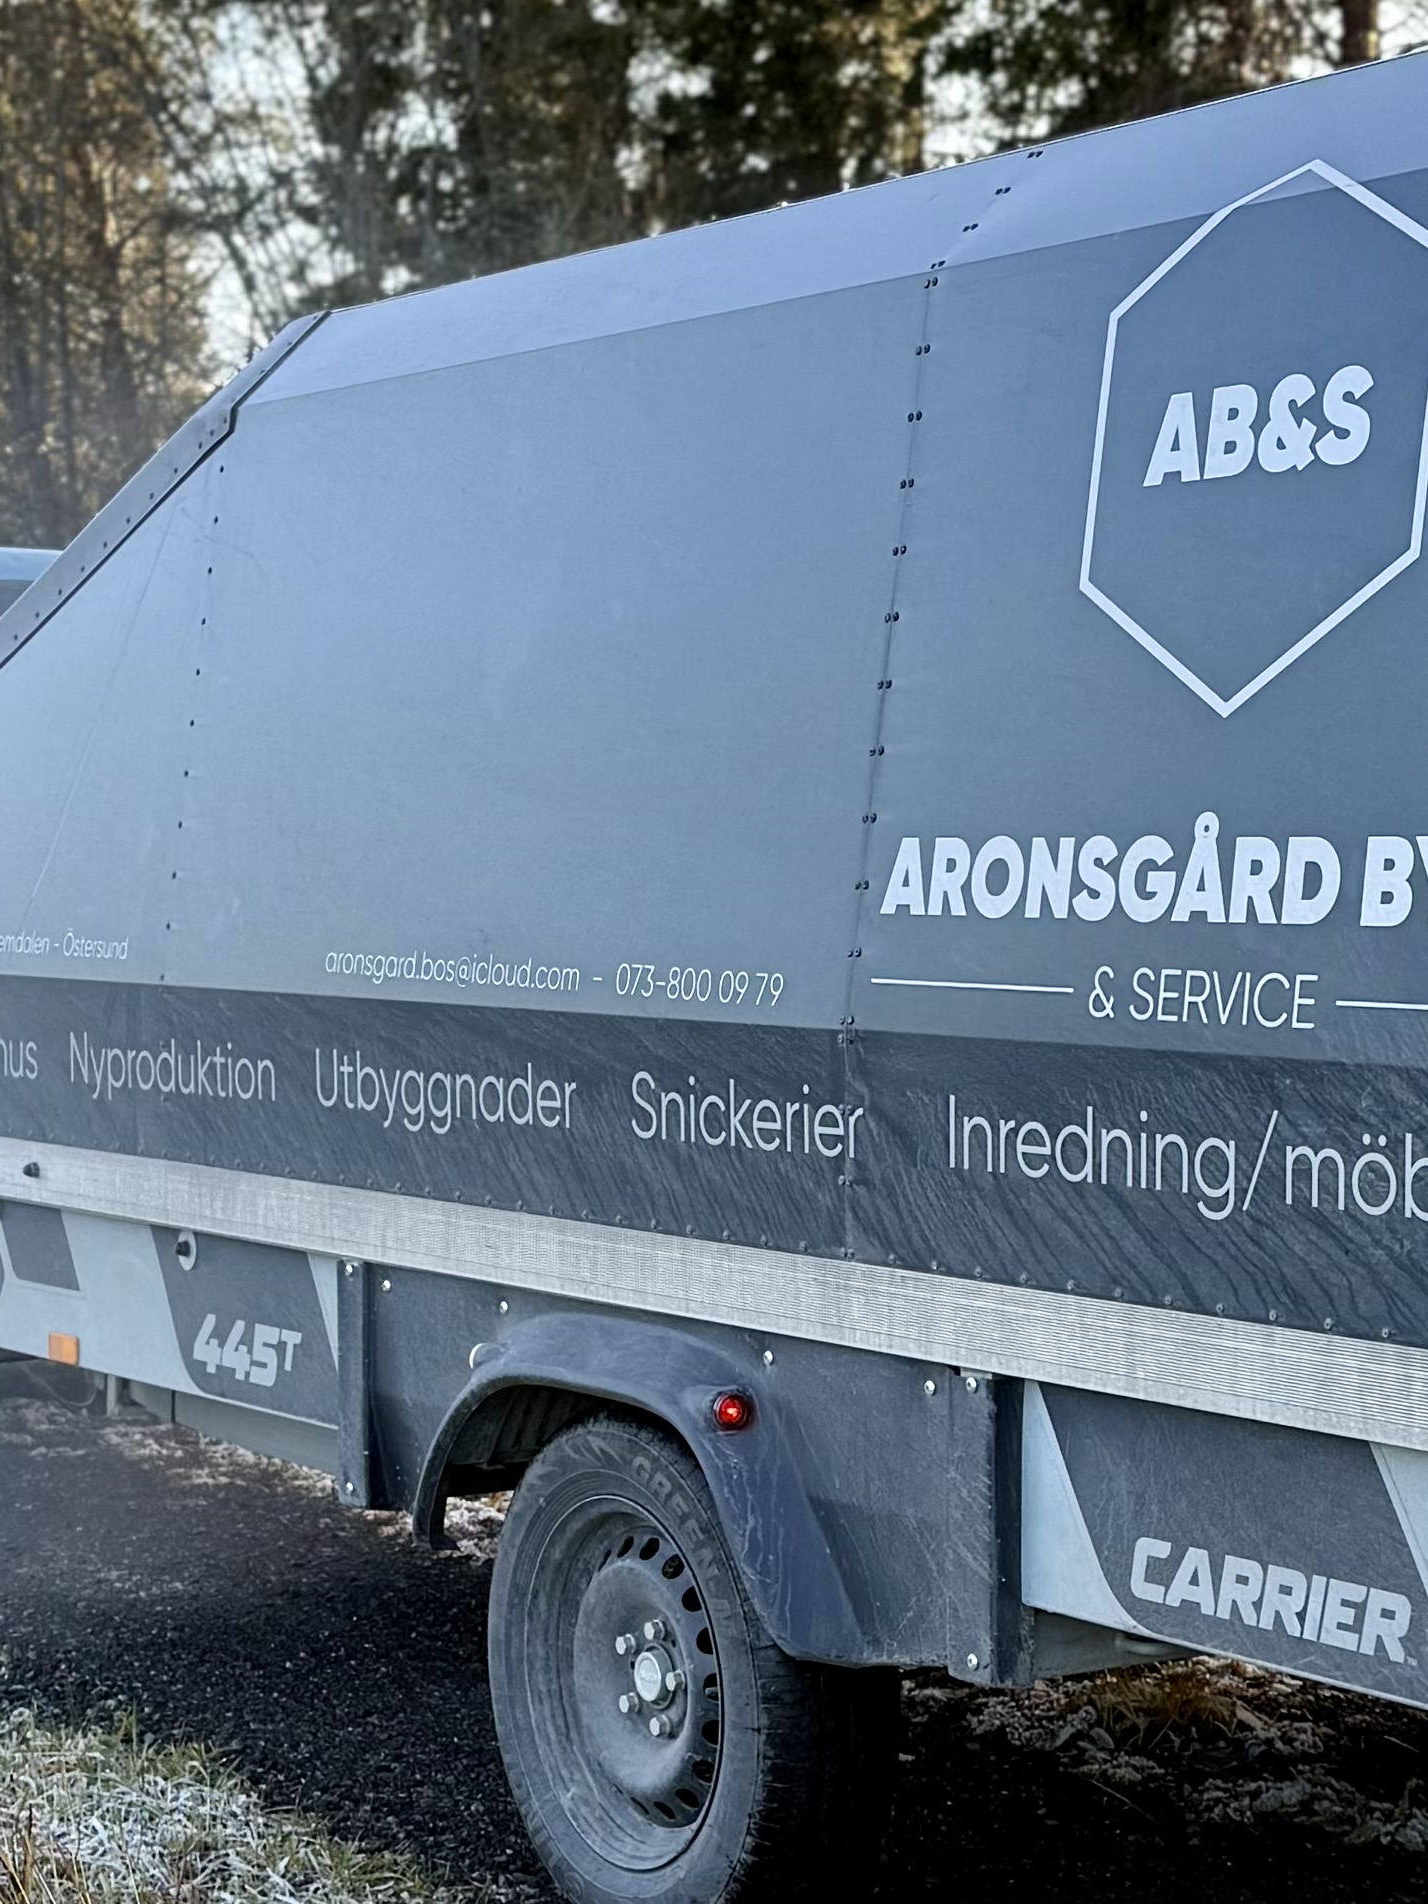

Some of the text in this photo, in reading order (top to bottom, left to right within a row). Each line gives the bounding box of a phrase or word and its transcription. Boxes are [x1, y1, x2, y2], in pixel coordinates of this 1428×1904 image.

[1142, 365, 1374, 487] AB&S
[879, 811, 1341, 925] ARONSGÅRD
[63, 927, 130, 960] Östersund
[325, 950, 580, 991] aronsgard.bos@icloud.com
[616, 963, 712, 1002] 073-800
[718, 970, 749, 1005] 09
[755, 972, 784, 1007] 79
[1088, 965, 1319, 1029] & SERVICE
[69, 1031, 276, 1102] Nyproduktion
[315, 1047, 577, 1135] Utbyggnader
[631, 1071, 864, 1159] Snickerier
[193, 1314, 302, 1387] 445T
[1131, 1537, 1412, 1664] CARRIER
